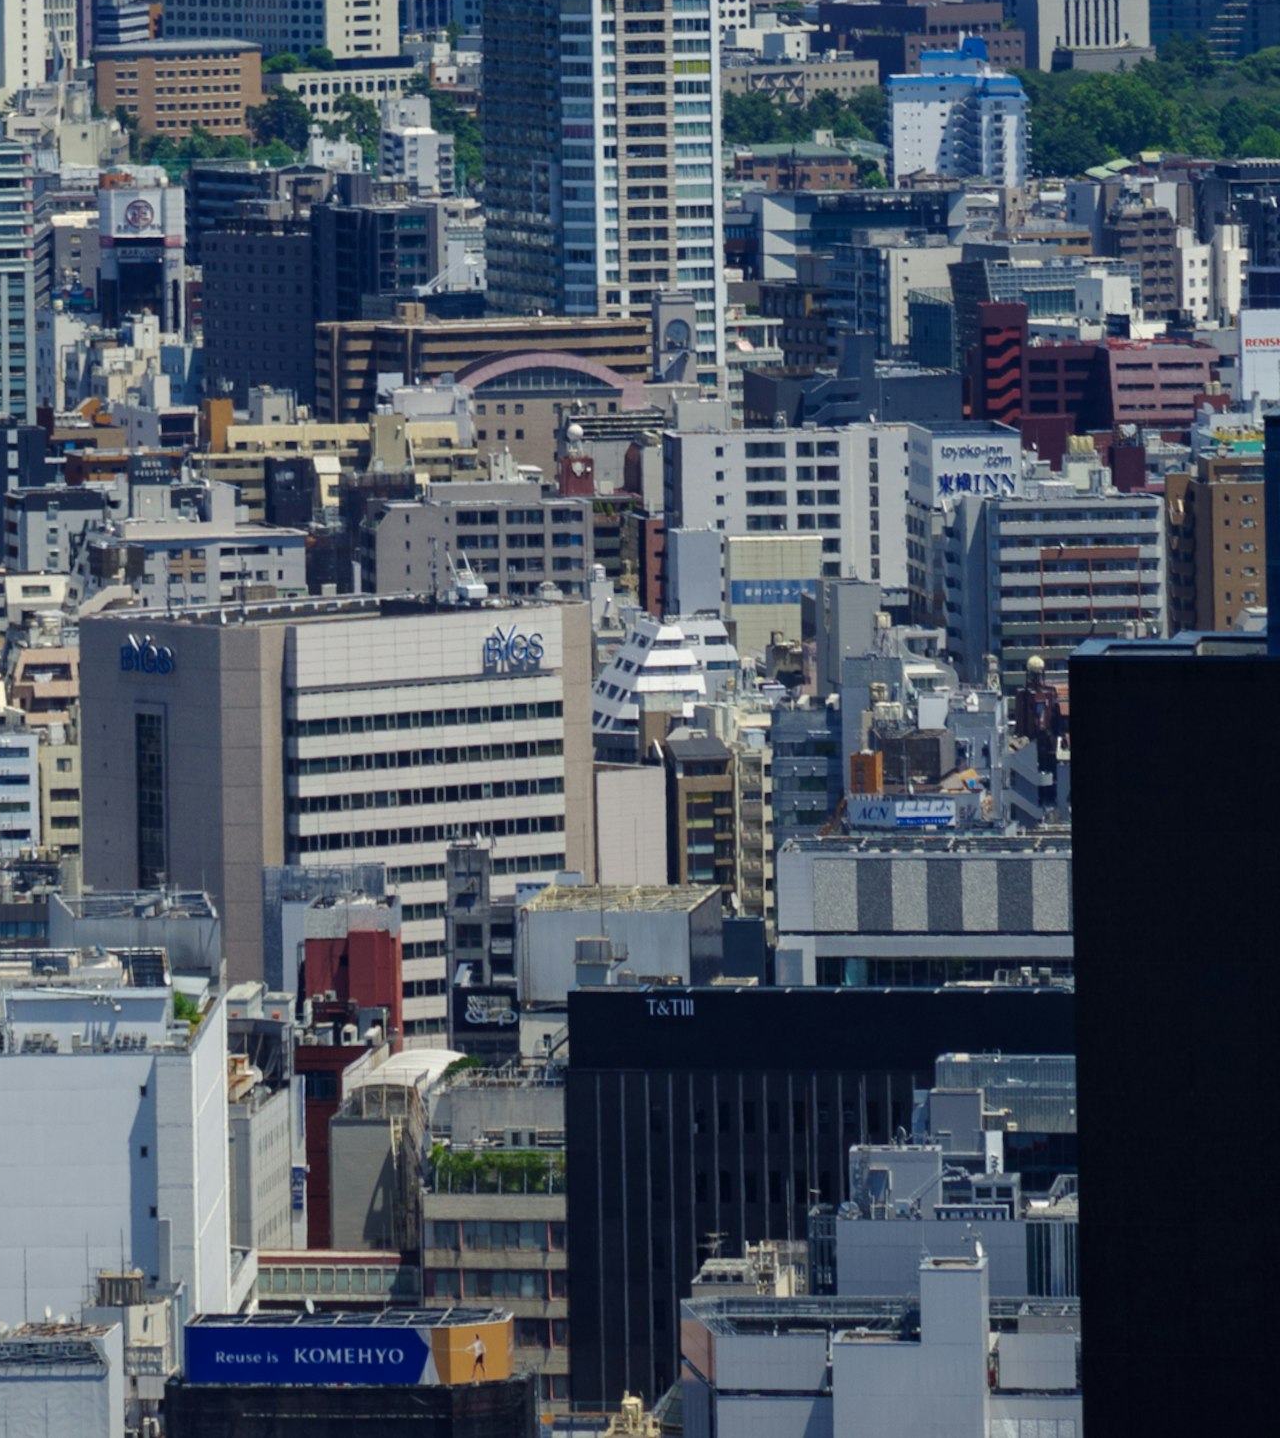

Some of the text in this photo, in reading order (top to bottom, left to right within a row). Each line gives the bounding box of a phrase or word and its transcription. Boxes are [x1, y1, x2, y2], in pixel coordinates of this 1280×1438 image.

[941, 444, 1003, 462] toyoko-inn
[983, 456, 1012, 469] .com
[937, 473, 1017, 497] 東横INN
[485, 623, 544, 662] BYGS
[120, 633, 174, 674] BYGS
[858, 805, 889, 821] ACN
[215, 1347, 406, 1365] Reuse is KOMEHYO
